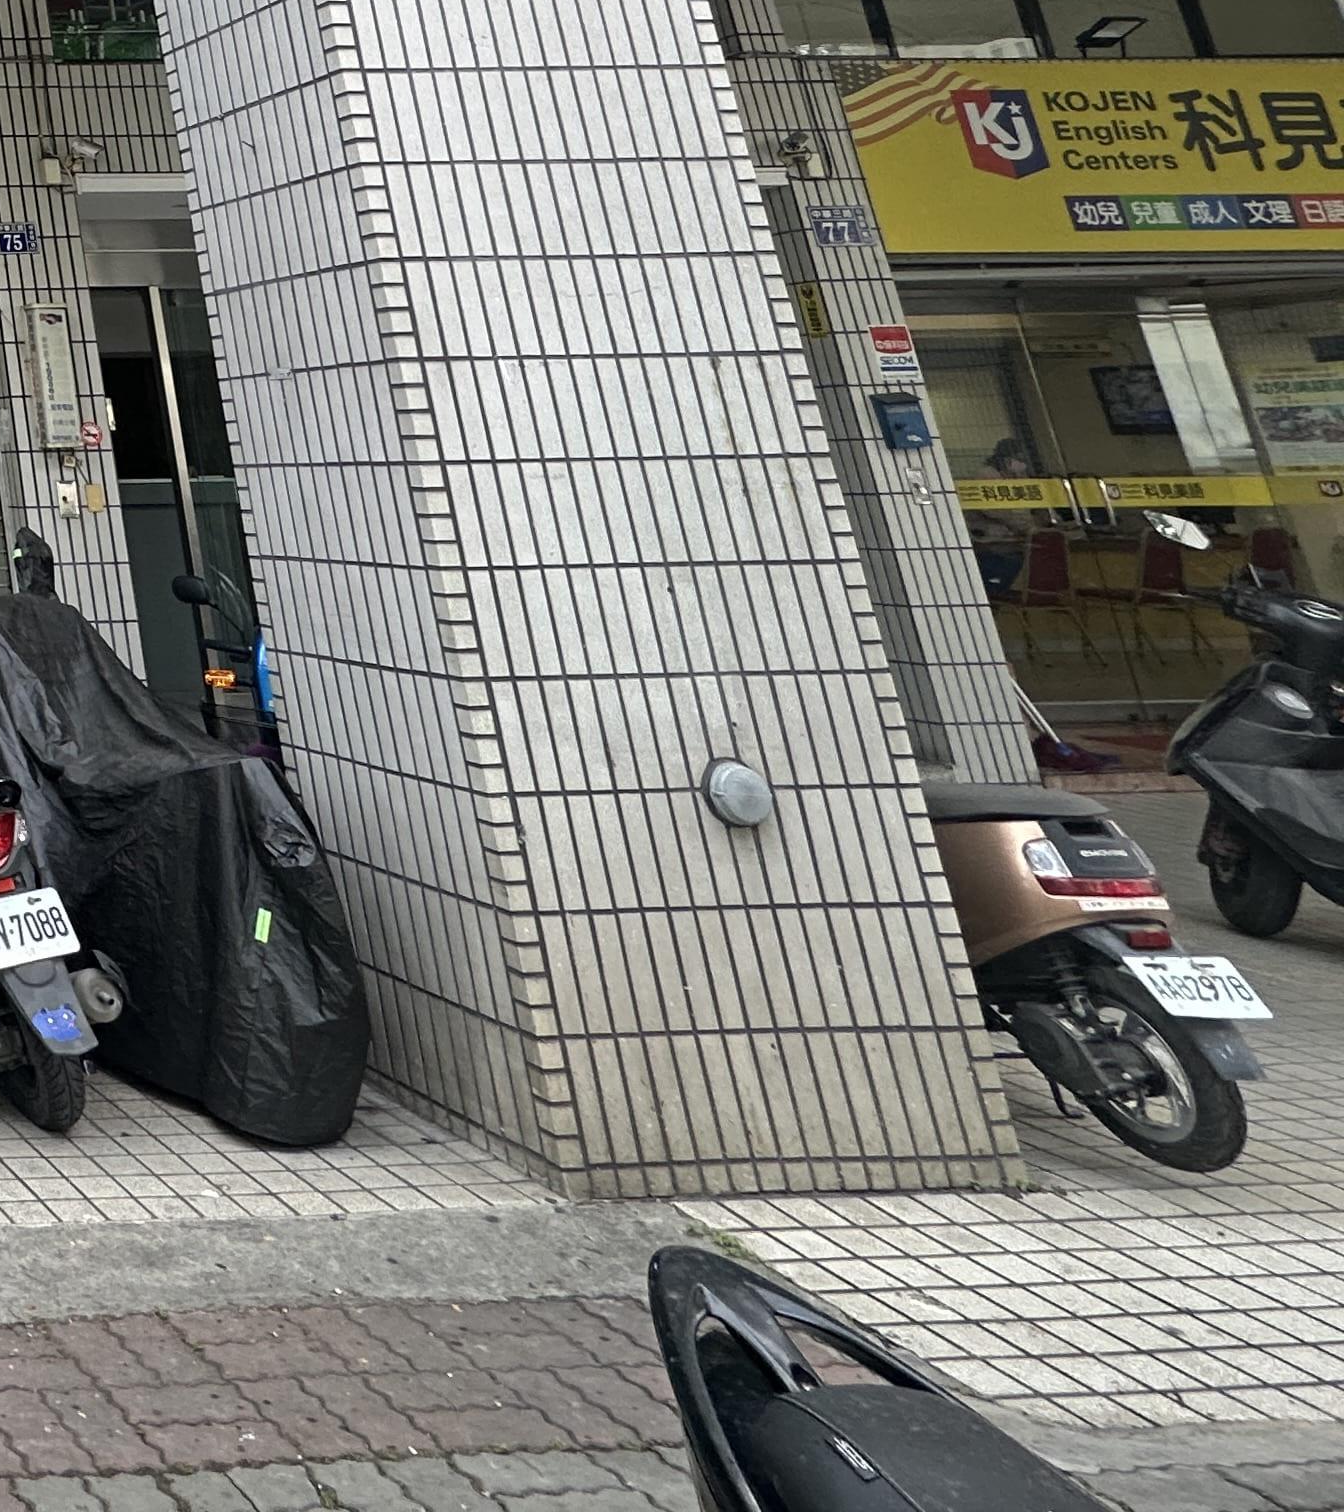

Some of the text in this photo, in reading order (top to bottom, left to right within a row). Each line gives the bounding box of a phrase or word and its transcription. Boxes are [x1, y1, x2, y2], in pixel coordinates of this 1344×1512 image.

[1042, 90, 1157, 113] KOJEN
[1052, 120, 1169, 145] English
[1168, 89, 1344, 171] 科見
[1062, 149, 1179, 171] Centers
[1073, 201, 1124, 226] 幼兒
[1188, 200, 1238, 225] 成人
[1243, 200, 1295, 224] 文理
[3, 234, 23, 251] 75
[822, 222, 850, 242] 77
